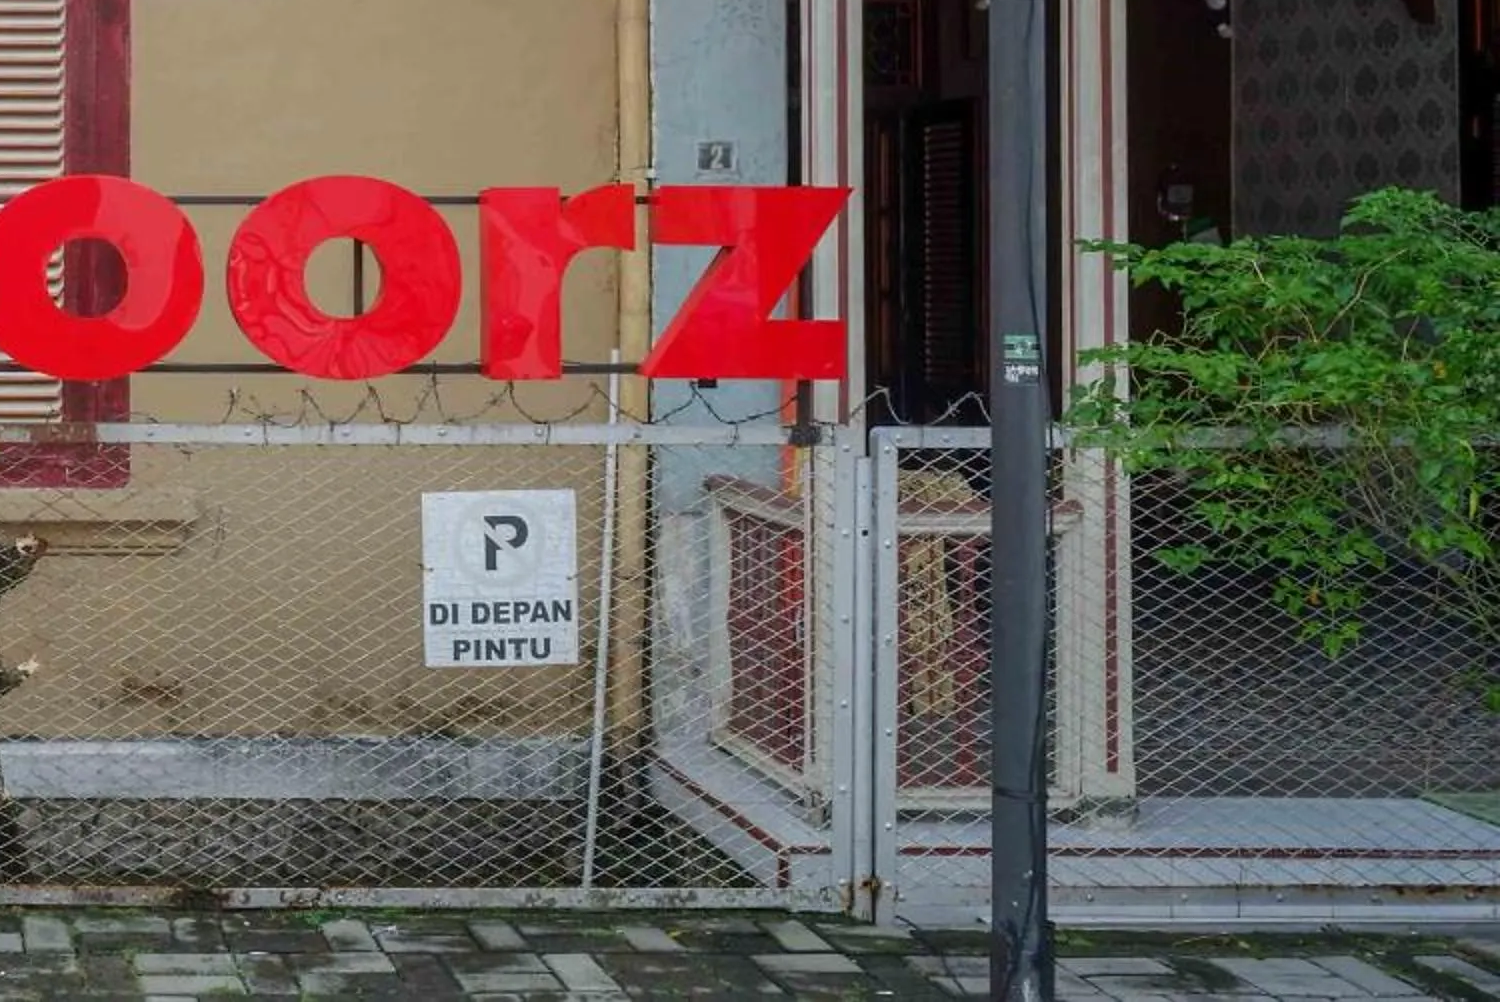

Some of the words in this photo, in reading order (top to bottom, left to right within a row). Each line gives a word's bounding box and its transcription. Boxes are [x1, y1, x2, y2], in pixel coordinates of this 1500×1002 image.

[484, 515, 529, 571] P
[429, 602, 460, 626] DI
[471, 599, 573, 625] DEPAN
[453, 637, 552, 662] PINTU
